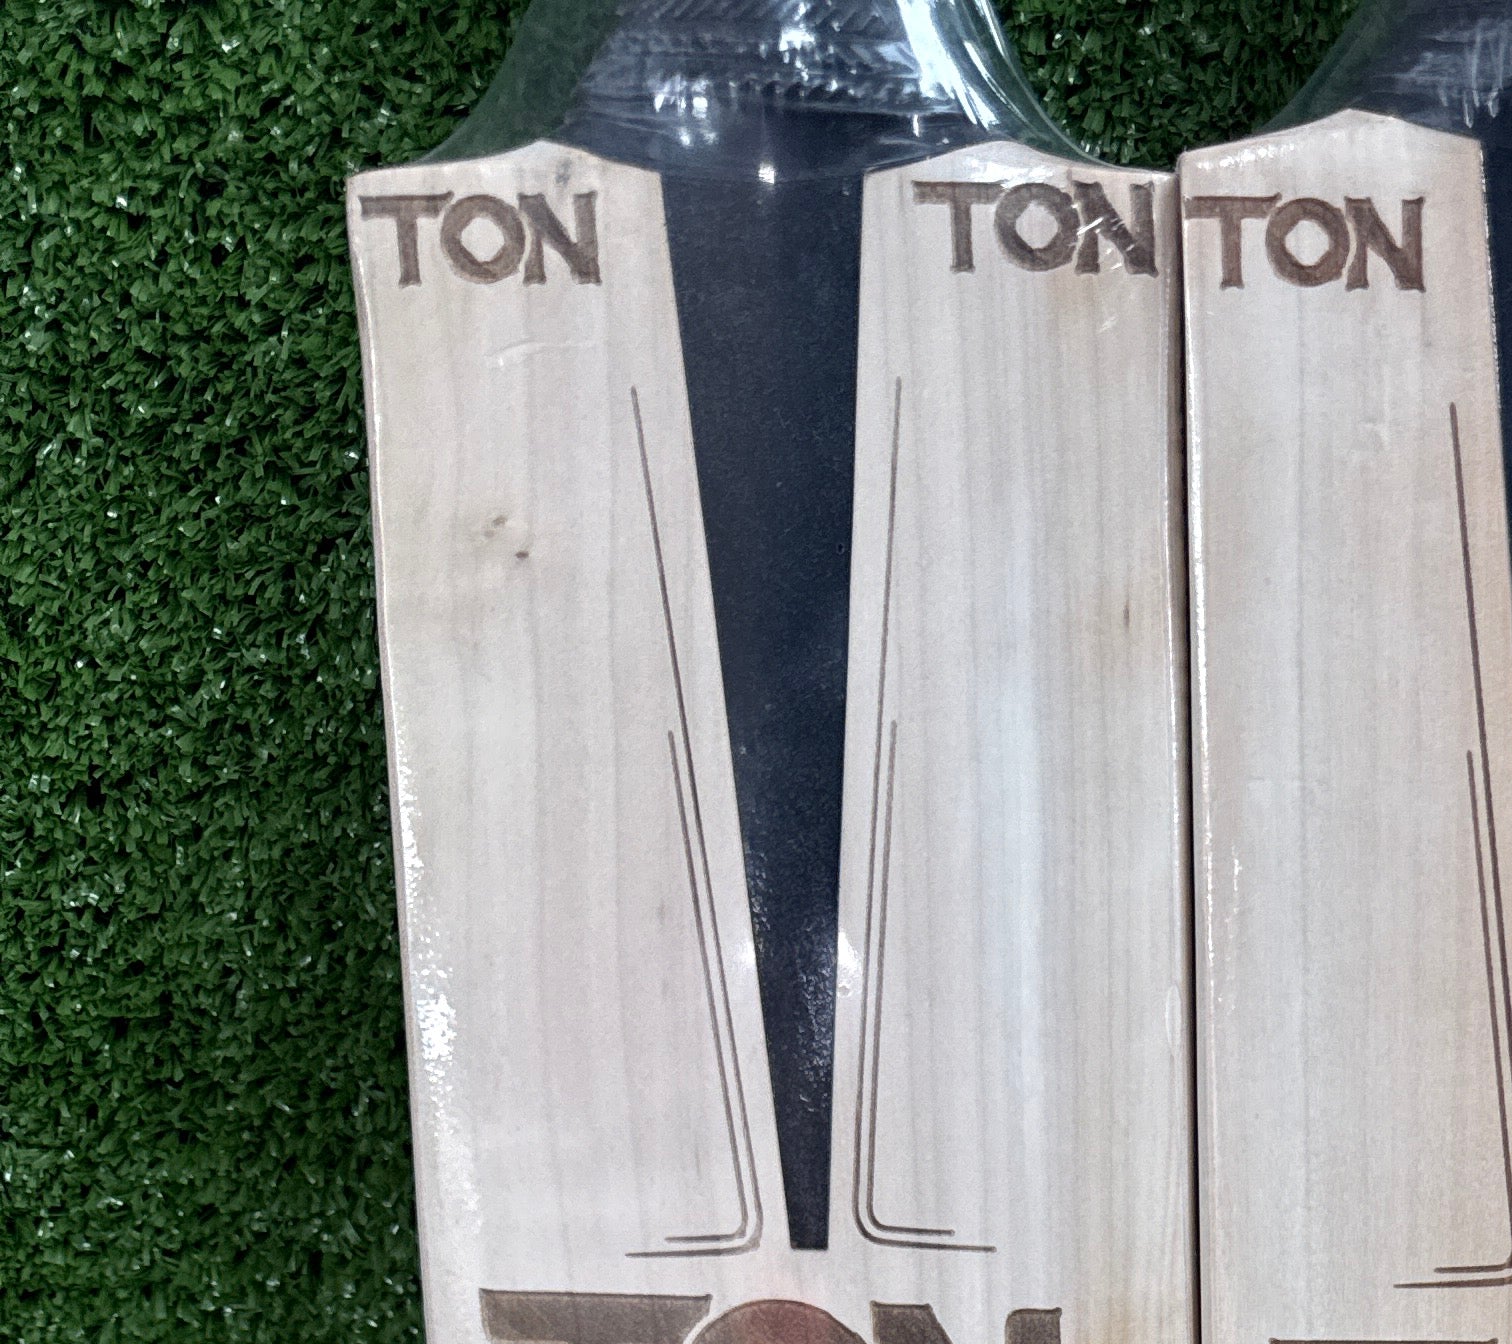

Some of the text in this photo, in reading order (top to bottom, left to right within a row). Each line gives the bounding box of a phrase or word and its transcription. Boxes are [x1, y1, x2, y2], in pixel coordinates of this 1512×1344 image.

[360, 190, 601, 287] TON
[913, 180, 1158, 278] TON
[1185, 192, 1426, 291] TON
